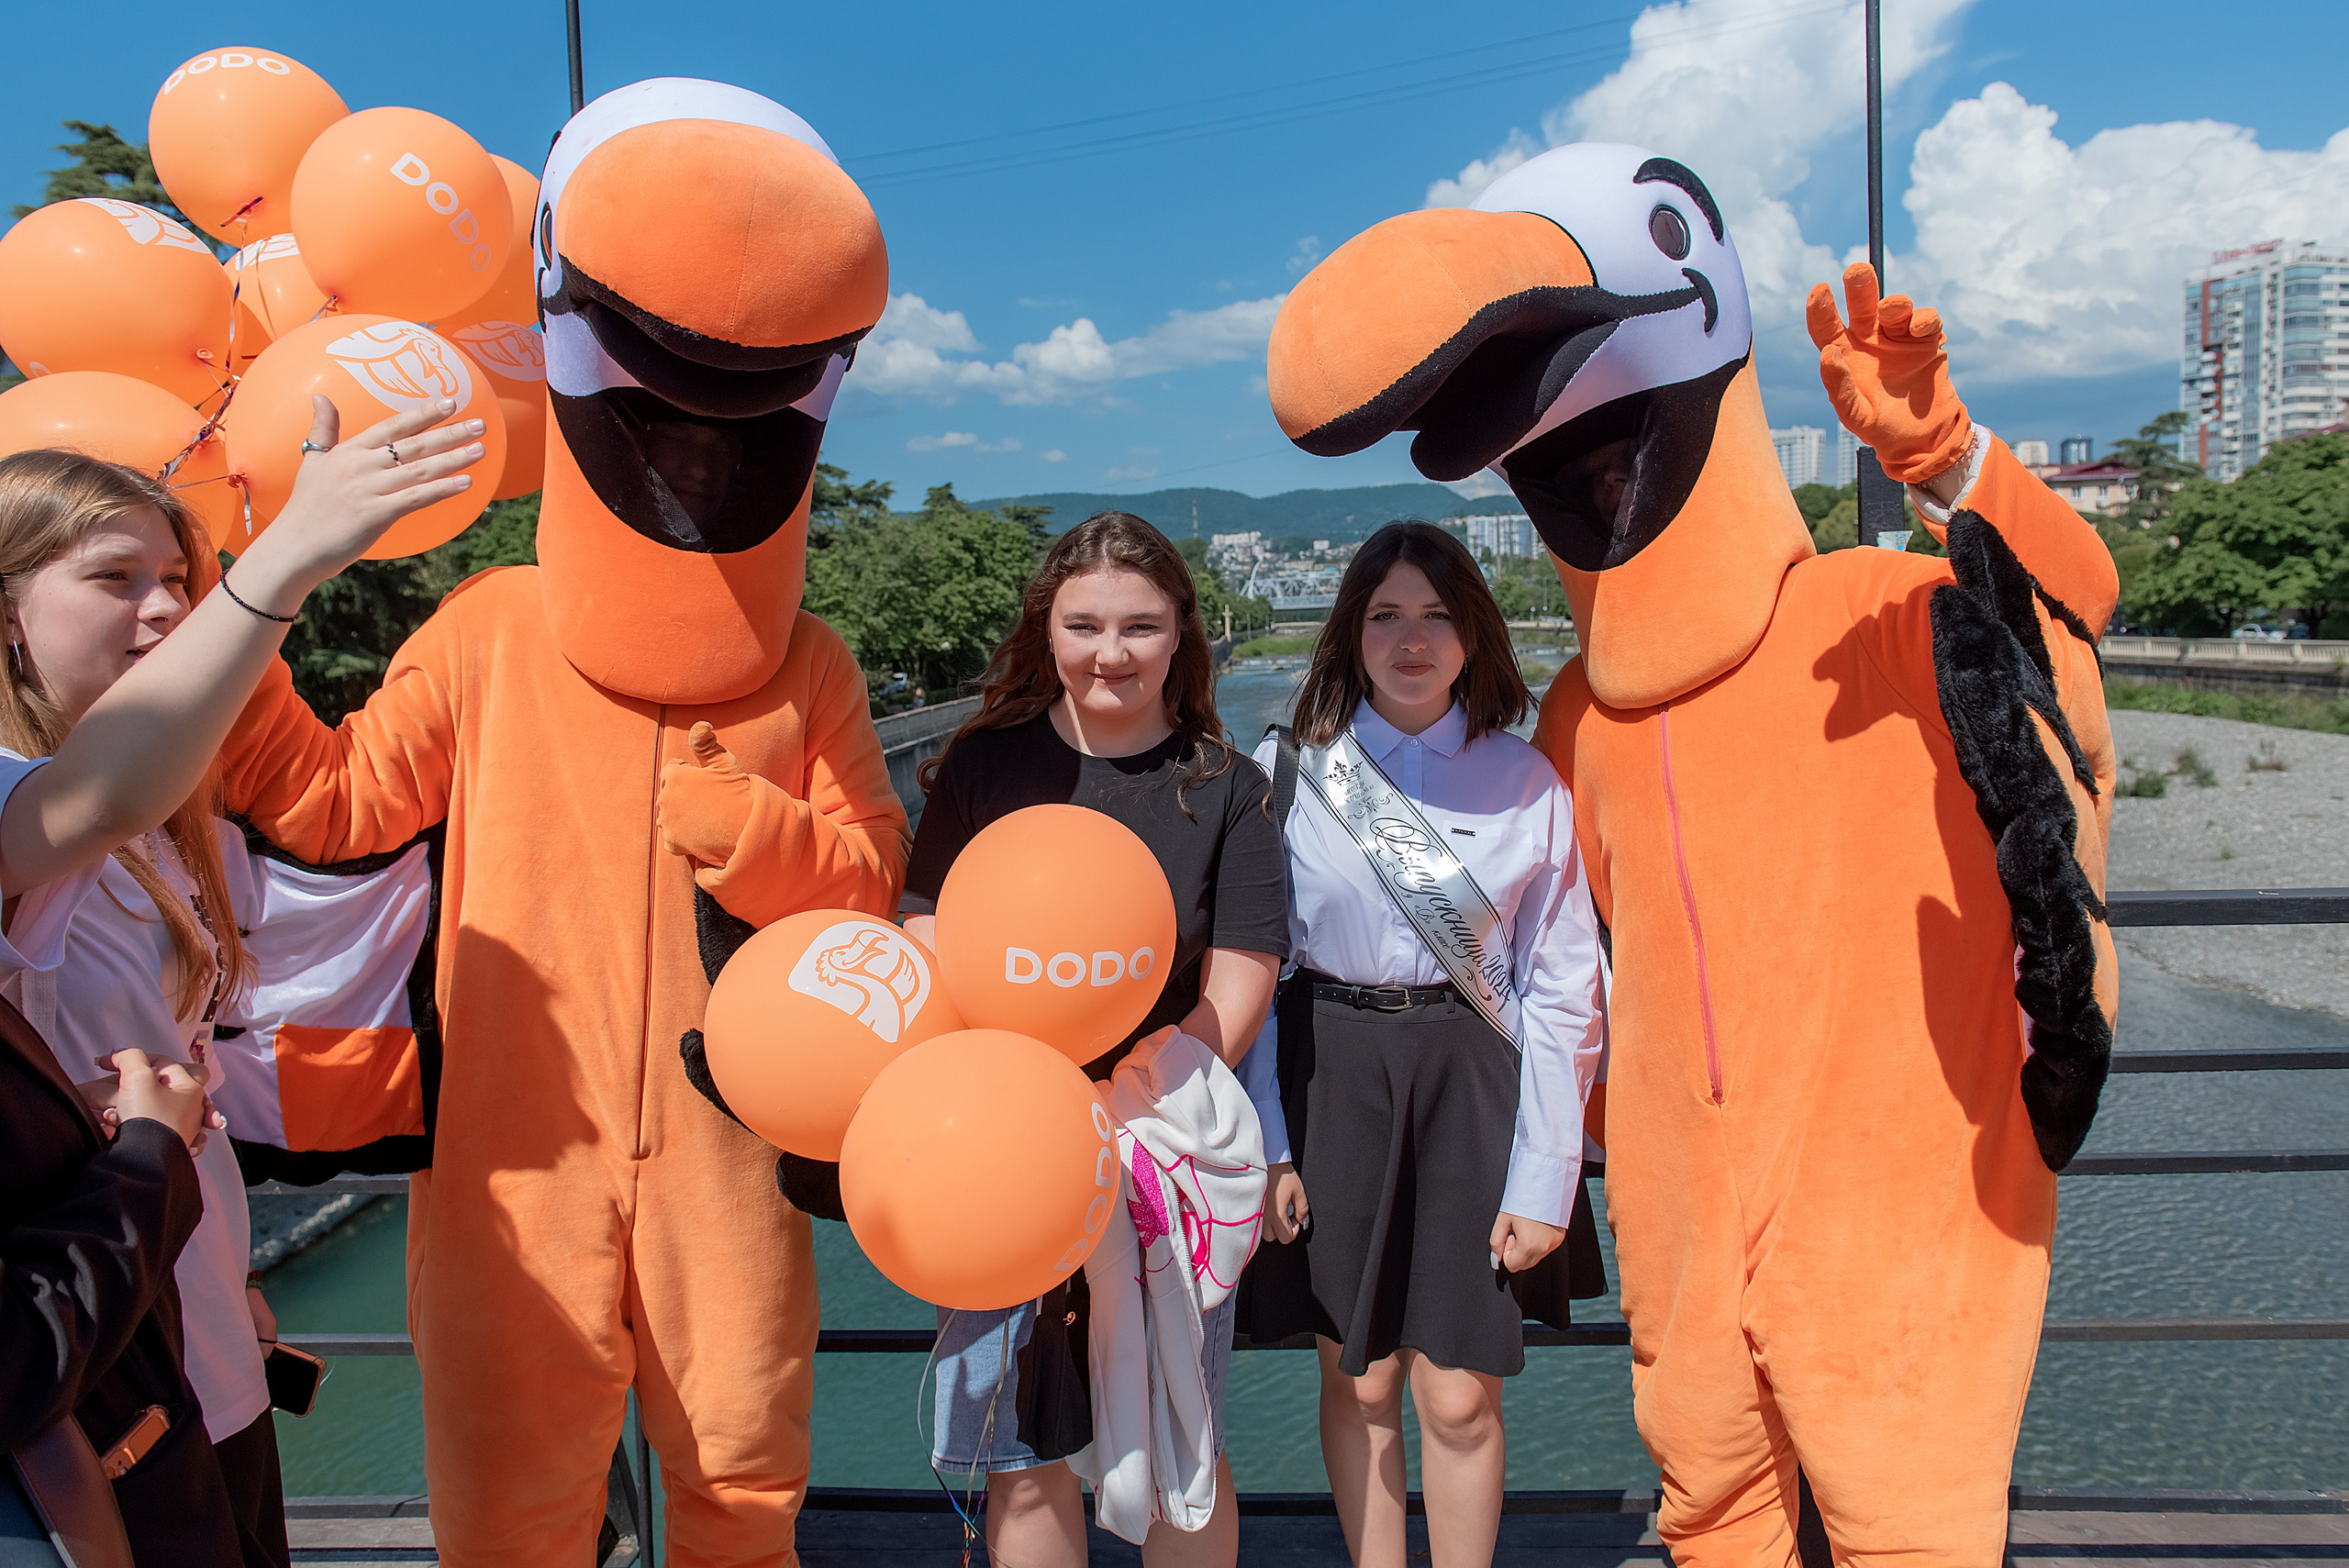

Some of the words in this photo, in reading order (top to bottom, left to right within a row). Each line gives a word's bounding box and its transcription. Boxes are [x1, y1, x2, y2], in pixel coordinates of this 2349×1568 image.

[163, 53, 291, 95] DODO
[390, 152, 492, 272] DODO
[1005, 946, 1156, 987] DODO
[1370, 817, 1487, 968] Выпускница
[1477, 954, 1512, 1013] 2024
[1052, 1102, 1115, 1273] DODO
